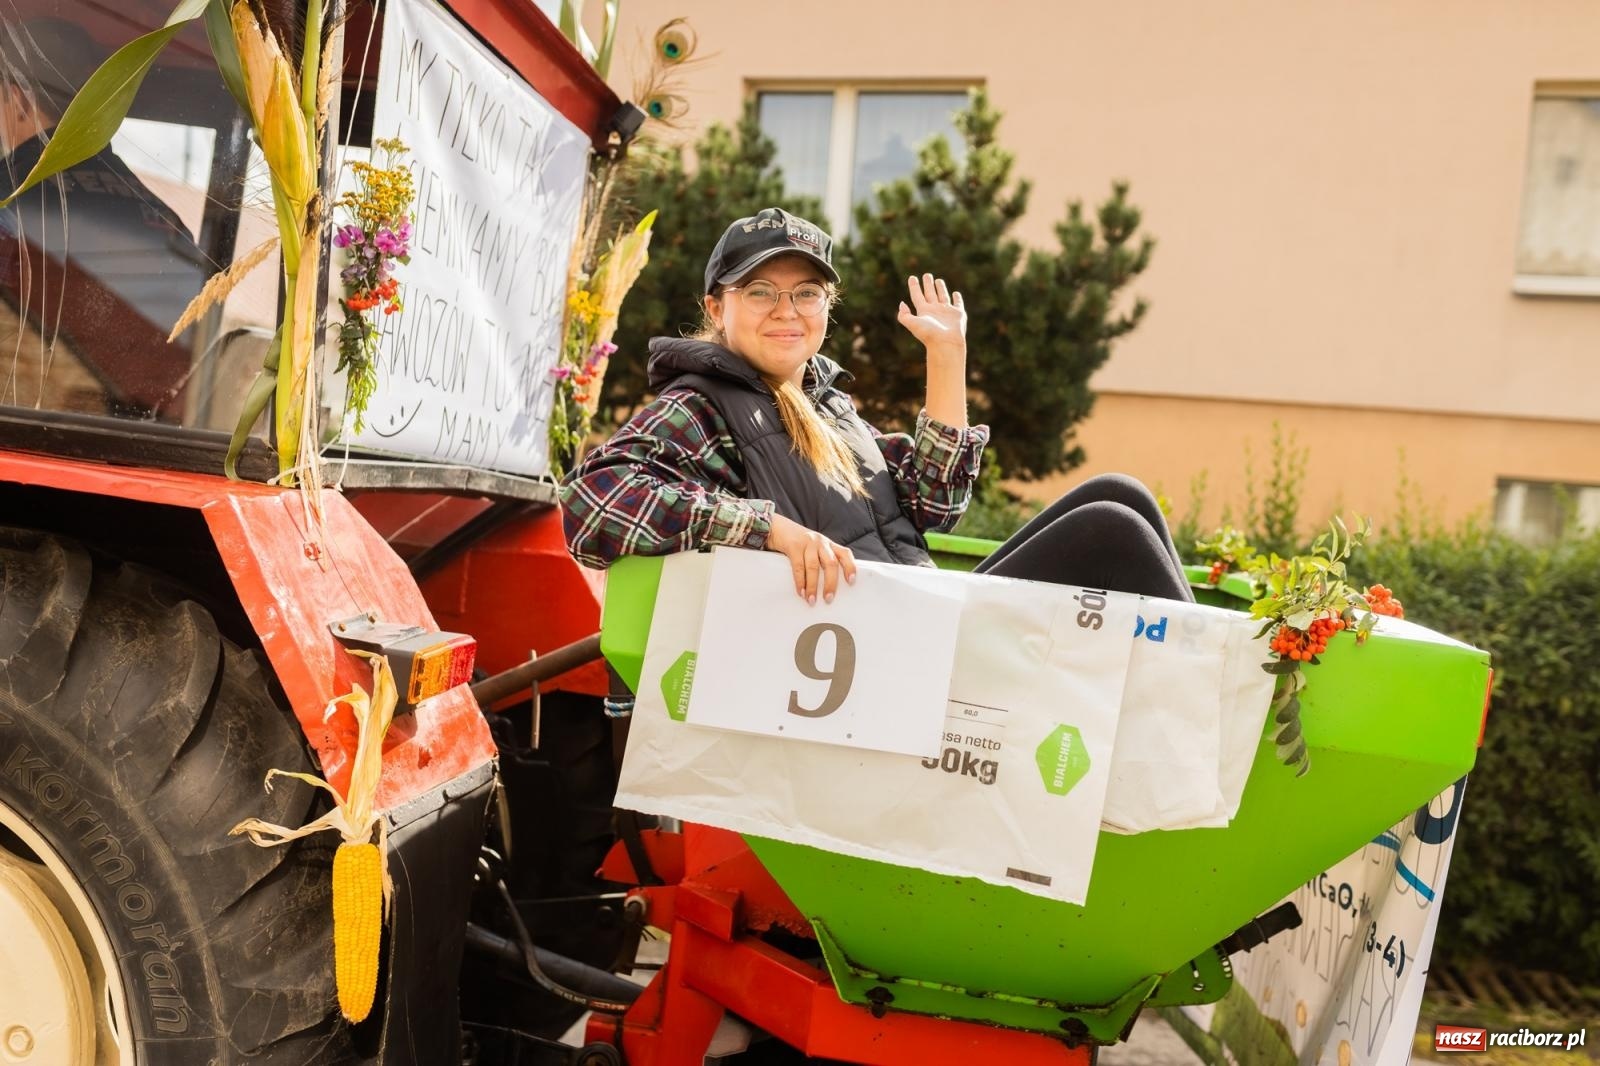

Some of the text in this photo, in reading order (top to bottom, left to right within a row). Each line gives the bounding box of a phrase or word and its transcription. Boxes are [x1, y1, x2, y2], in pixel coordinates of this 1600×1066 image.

[396, 28, 438, 120] MY
[438, 60, 506, 174] TYLKO
[400, 145, 529, 306] IEMNIAMY
[433, 406, 508, 467] MAMY
[677, 659, 696, 715] BIALCHEM
[787, 622, 857, 718] 9
[942, 731, 1002, 751] sa netto
[1053, 732, 1073, 788] BIALCHEM
